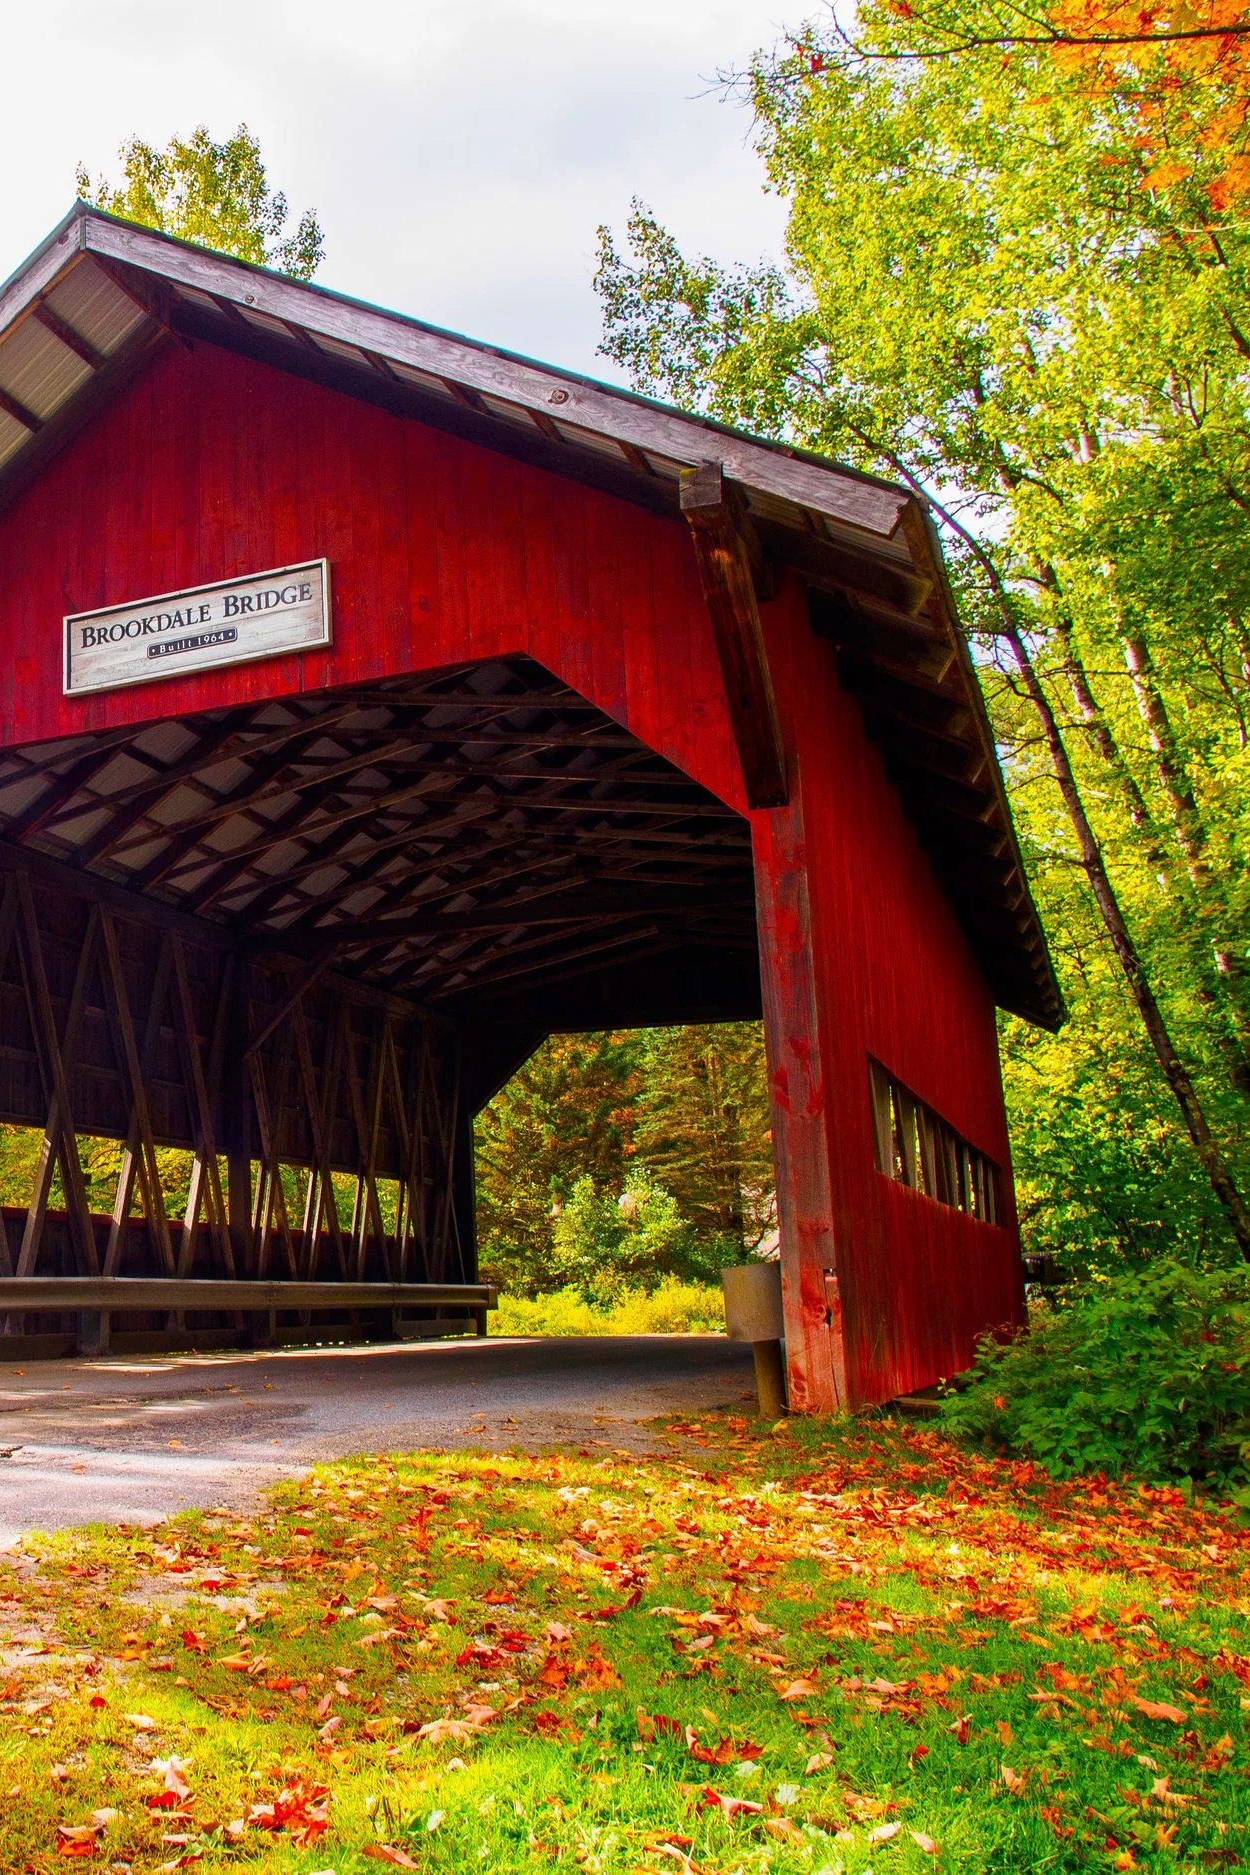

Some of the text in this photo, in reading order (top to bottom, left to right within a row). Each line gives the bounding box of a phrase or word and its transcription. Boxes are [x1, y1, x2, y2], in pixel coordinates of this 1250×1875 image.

[80, 582, 313, 648] BROOKDALE BRIDGE
[159, 632, 225, 654] Built 1964
